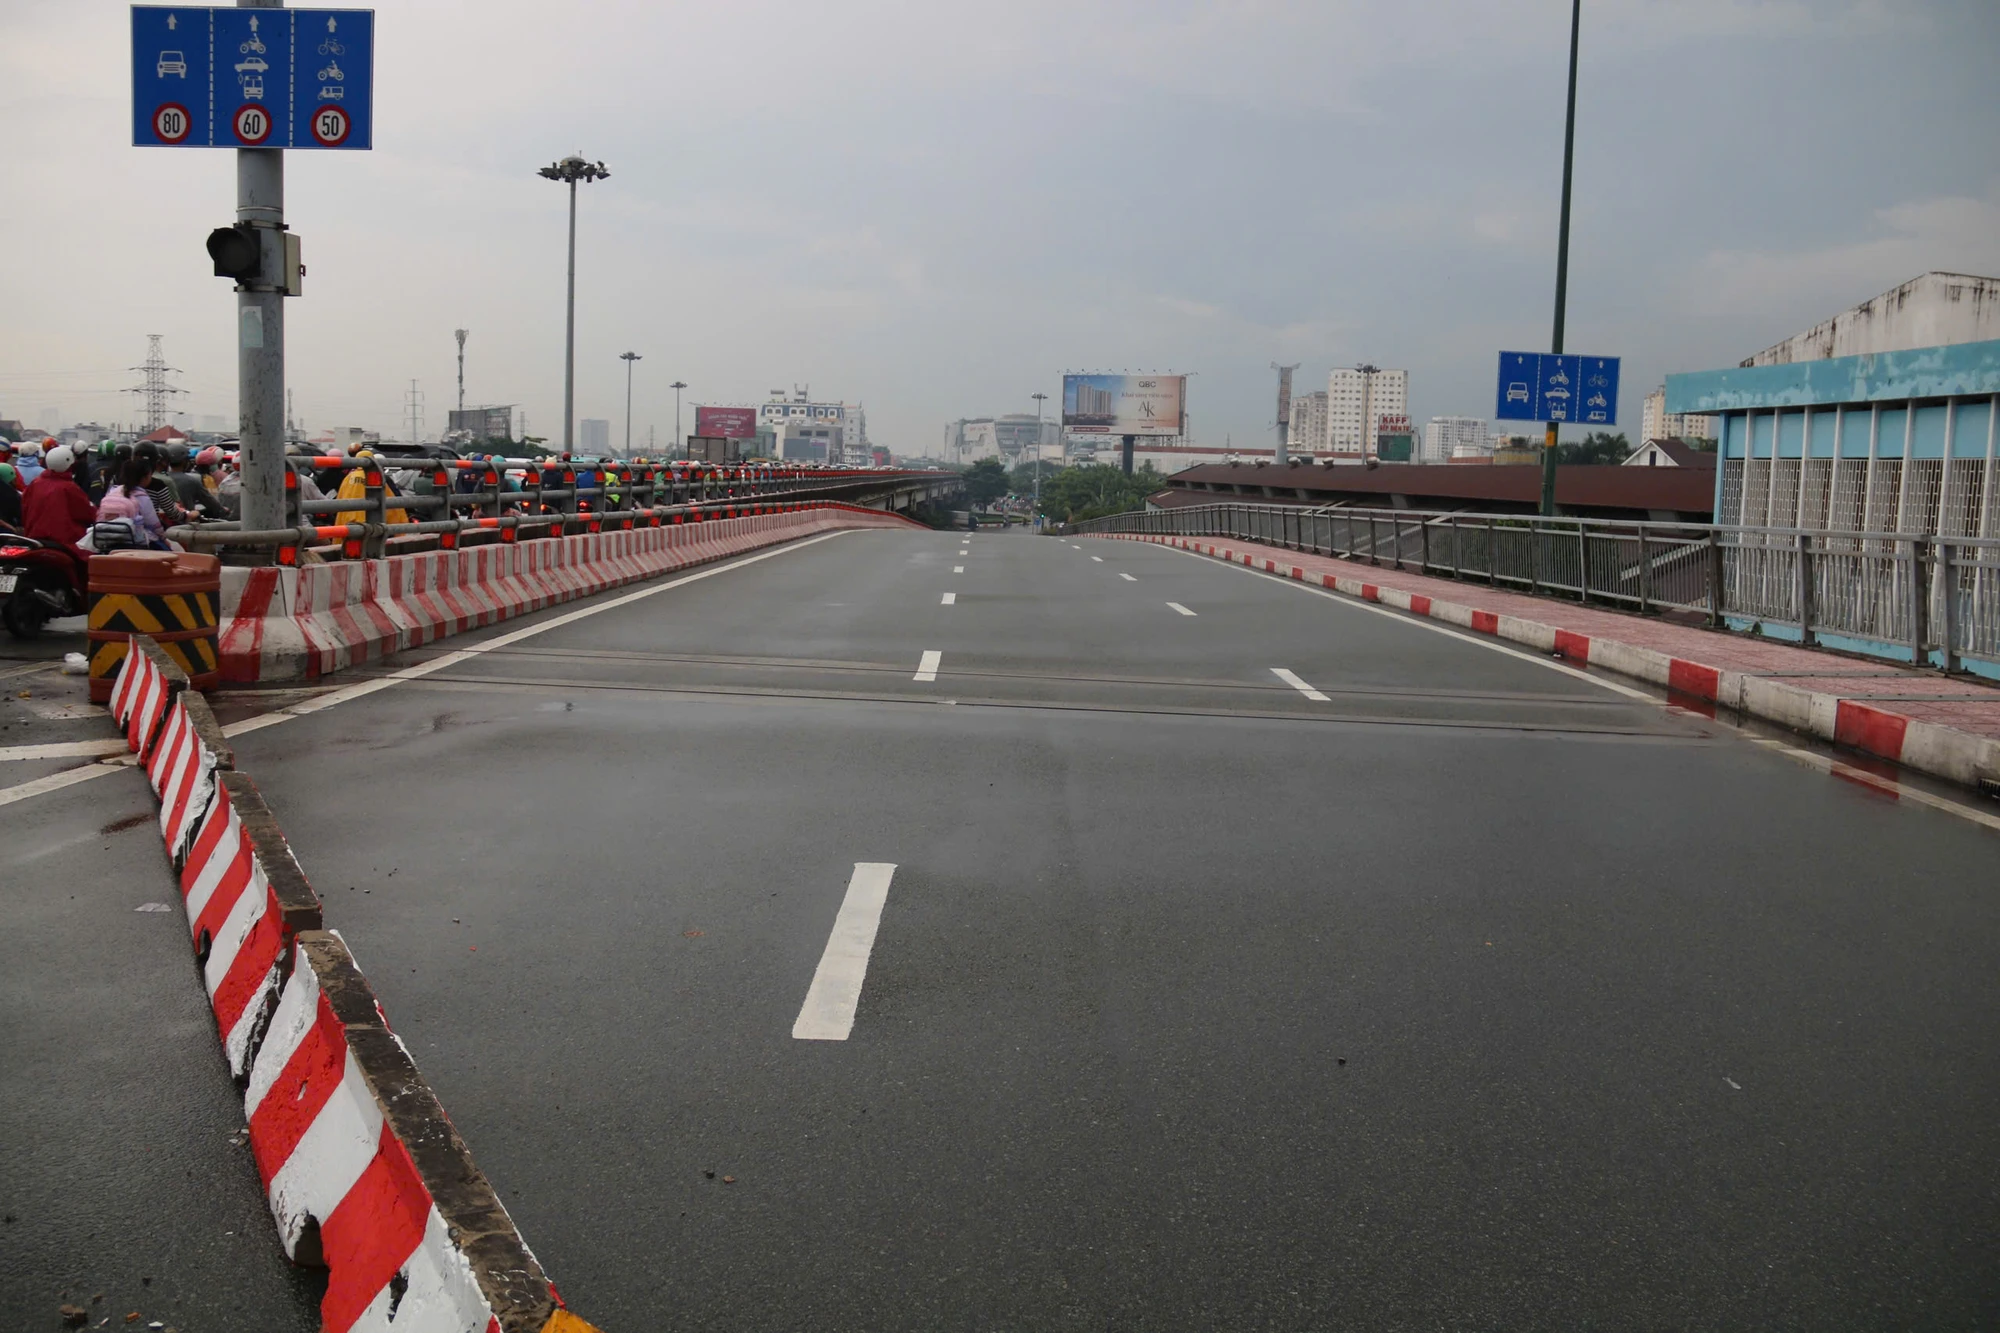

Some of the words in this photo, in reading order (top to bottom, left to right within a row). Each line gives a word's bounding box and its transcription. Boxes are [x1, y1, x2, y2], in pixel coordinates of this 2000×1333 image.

[163, 112, 180, 134] 80
[243, 113, 261, 135] 60
[321, 115, 339, 137] 50
[1382, 416, 1407, 424] KAFF
